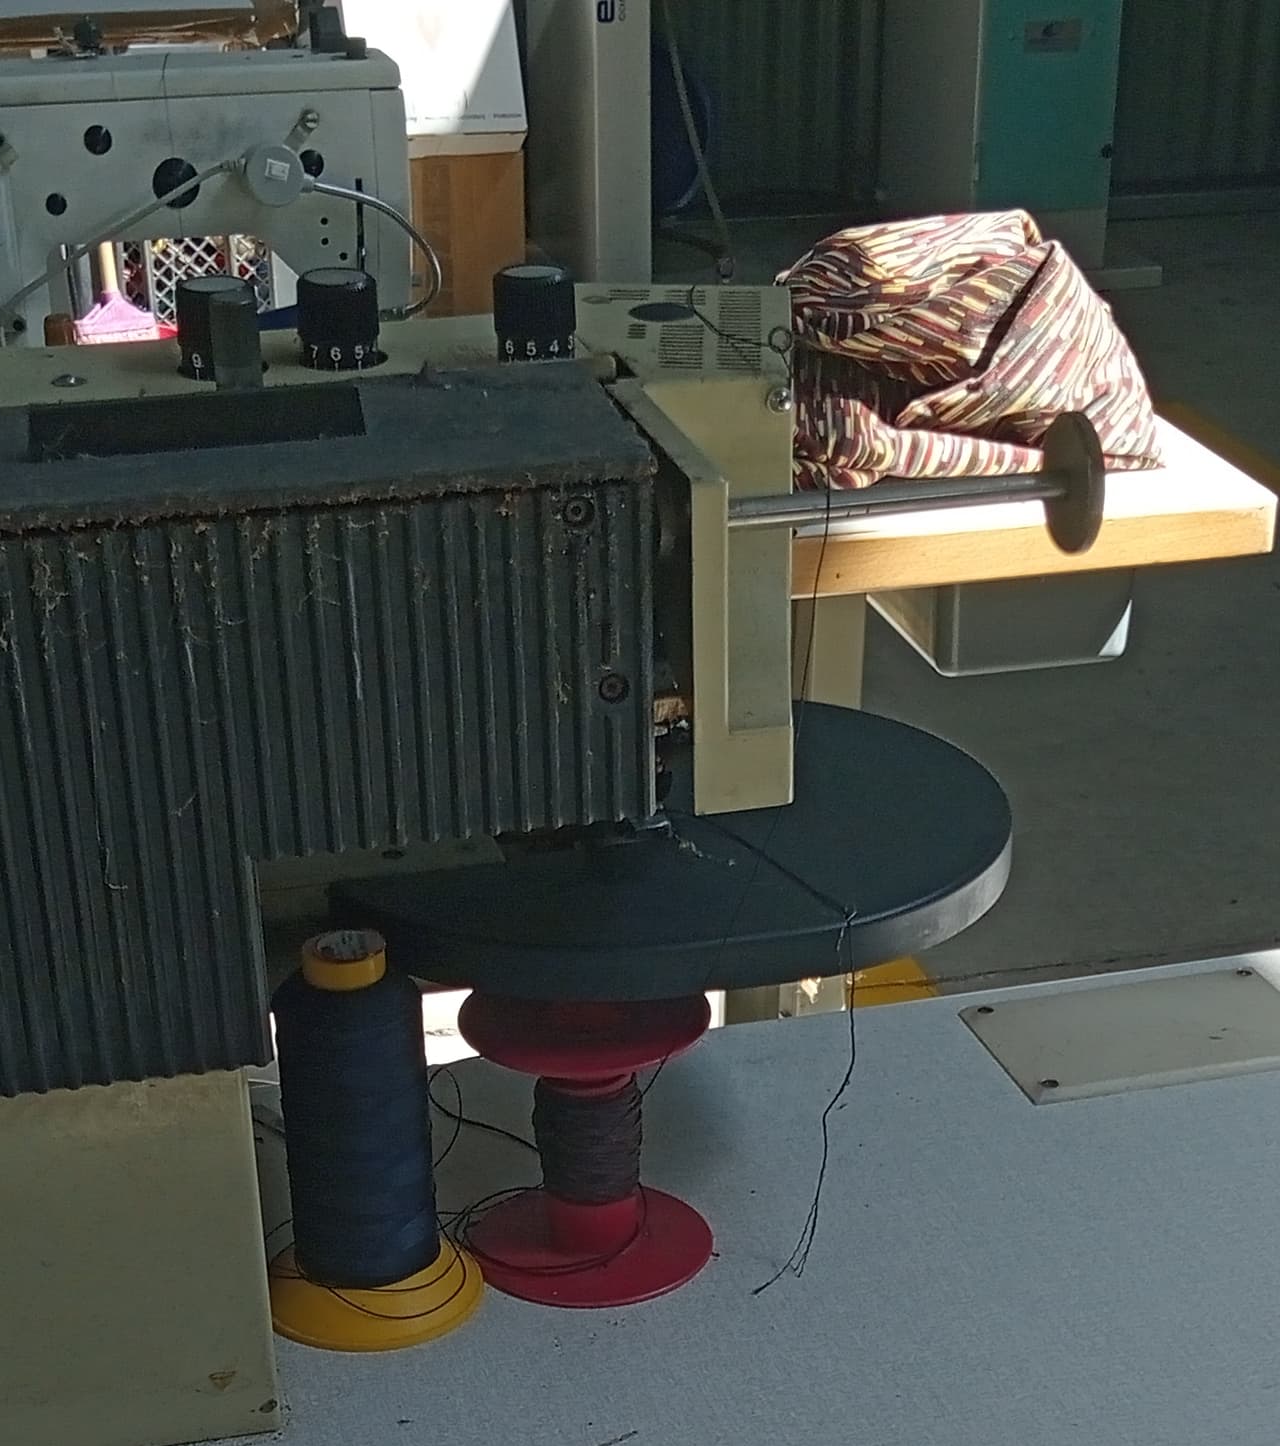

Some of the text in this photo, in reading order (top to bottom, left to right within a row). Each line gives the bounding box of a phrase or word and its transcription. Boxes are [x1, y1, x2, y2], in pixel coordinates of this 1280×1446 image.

[330, 346, 342, 361] 6
[354, 345, 364, 360] 5
[505, 340, 514, 354] 6
[526, 344, 537, 356] 5
